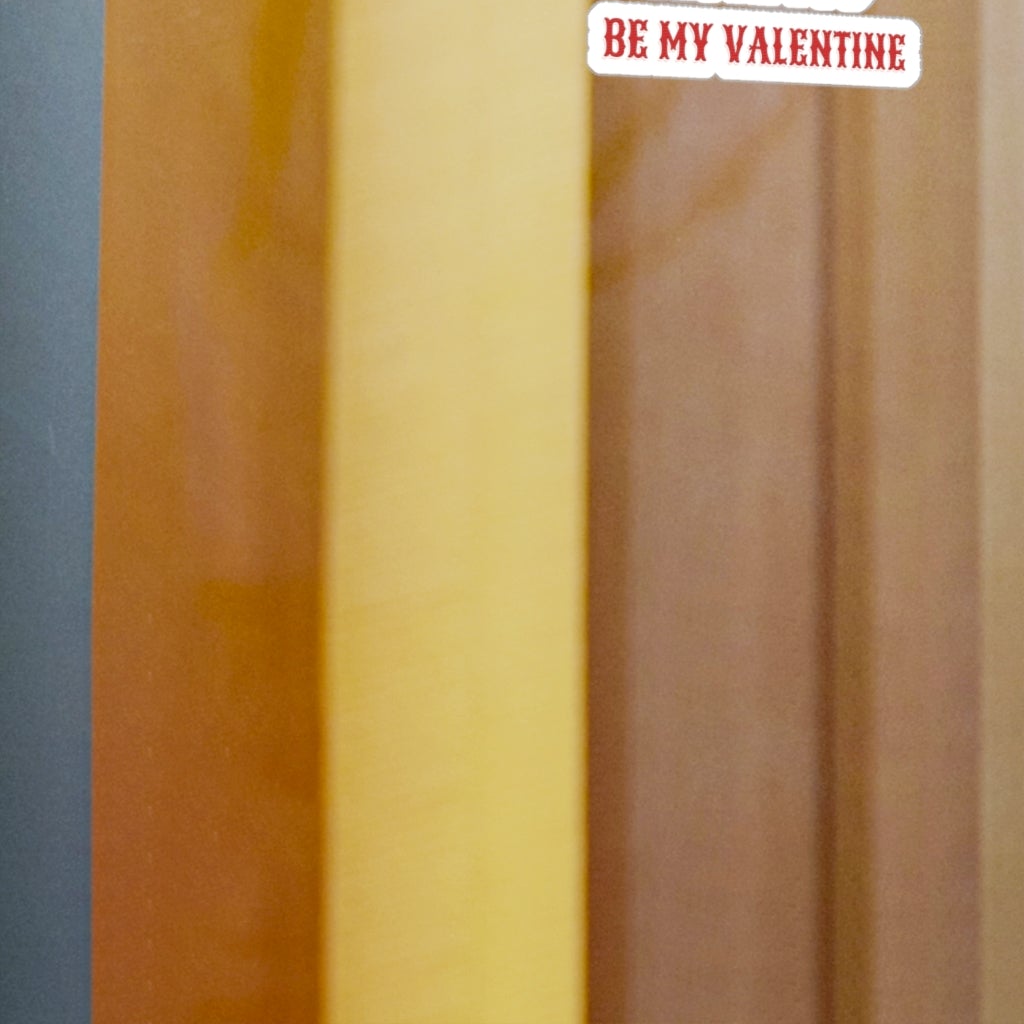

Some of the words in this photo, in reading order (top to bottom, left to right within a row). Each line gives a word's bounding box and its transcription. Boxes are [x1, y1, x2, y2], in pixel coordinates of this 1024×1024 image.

[603, 17, 649, 59] BE
[659, 20, 714, 62] MY
[722, 24, 906, 71] VALENTINE
